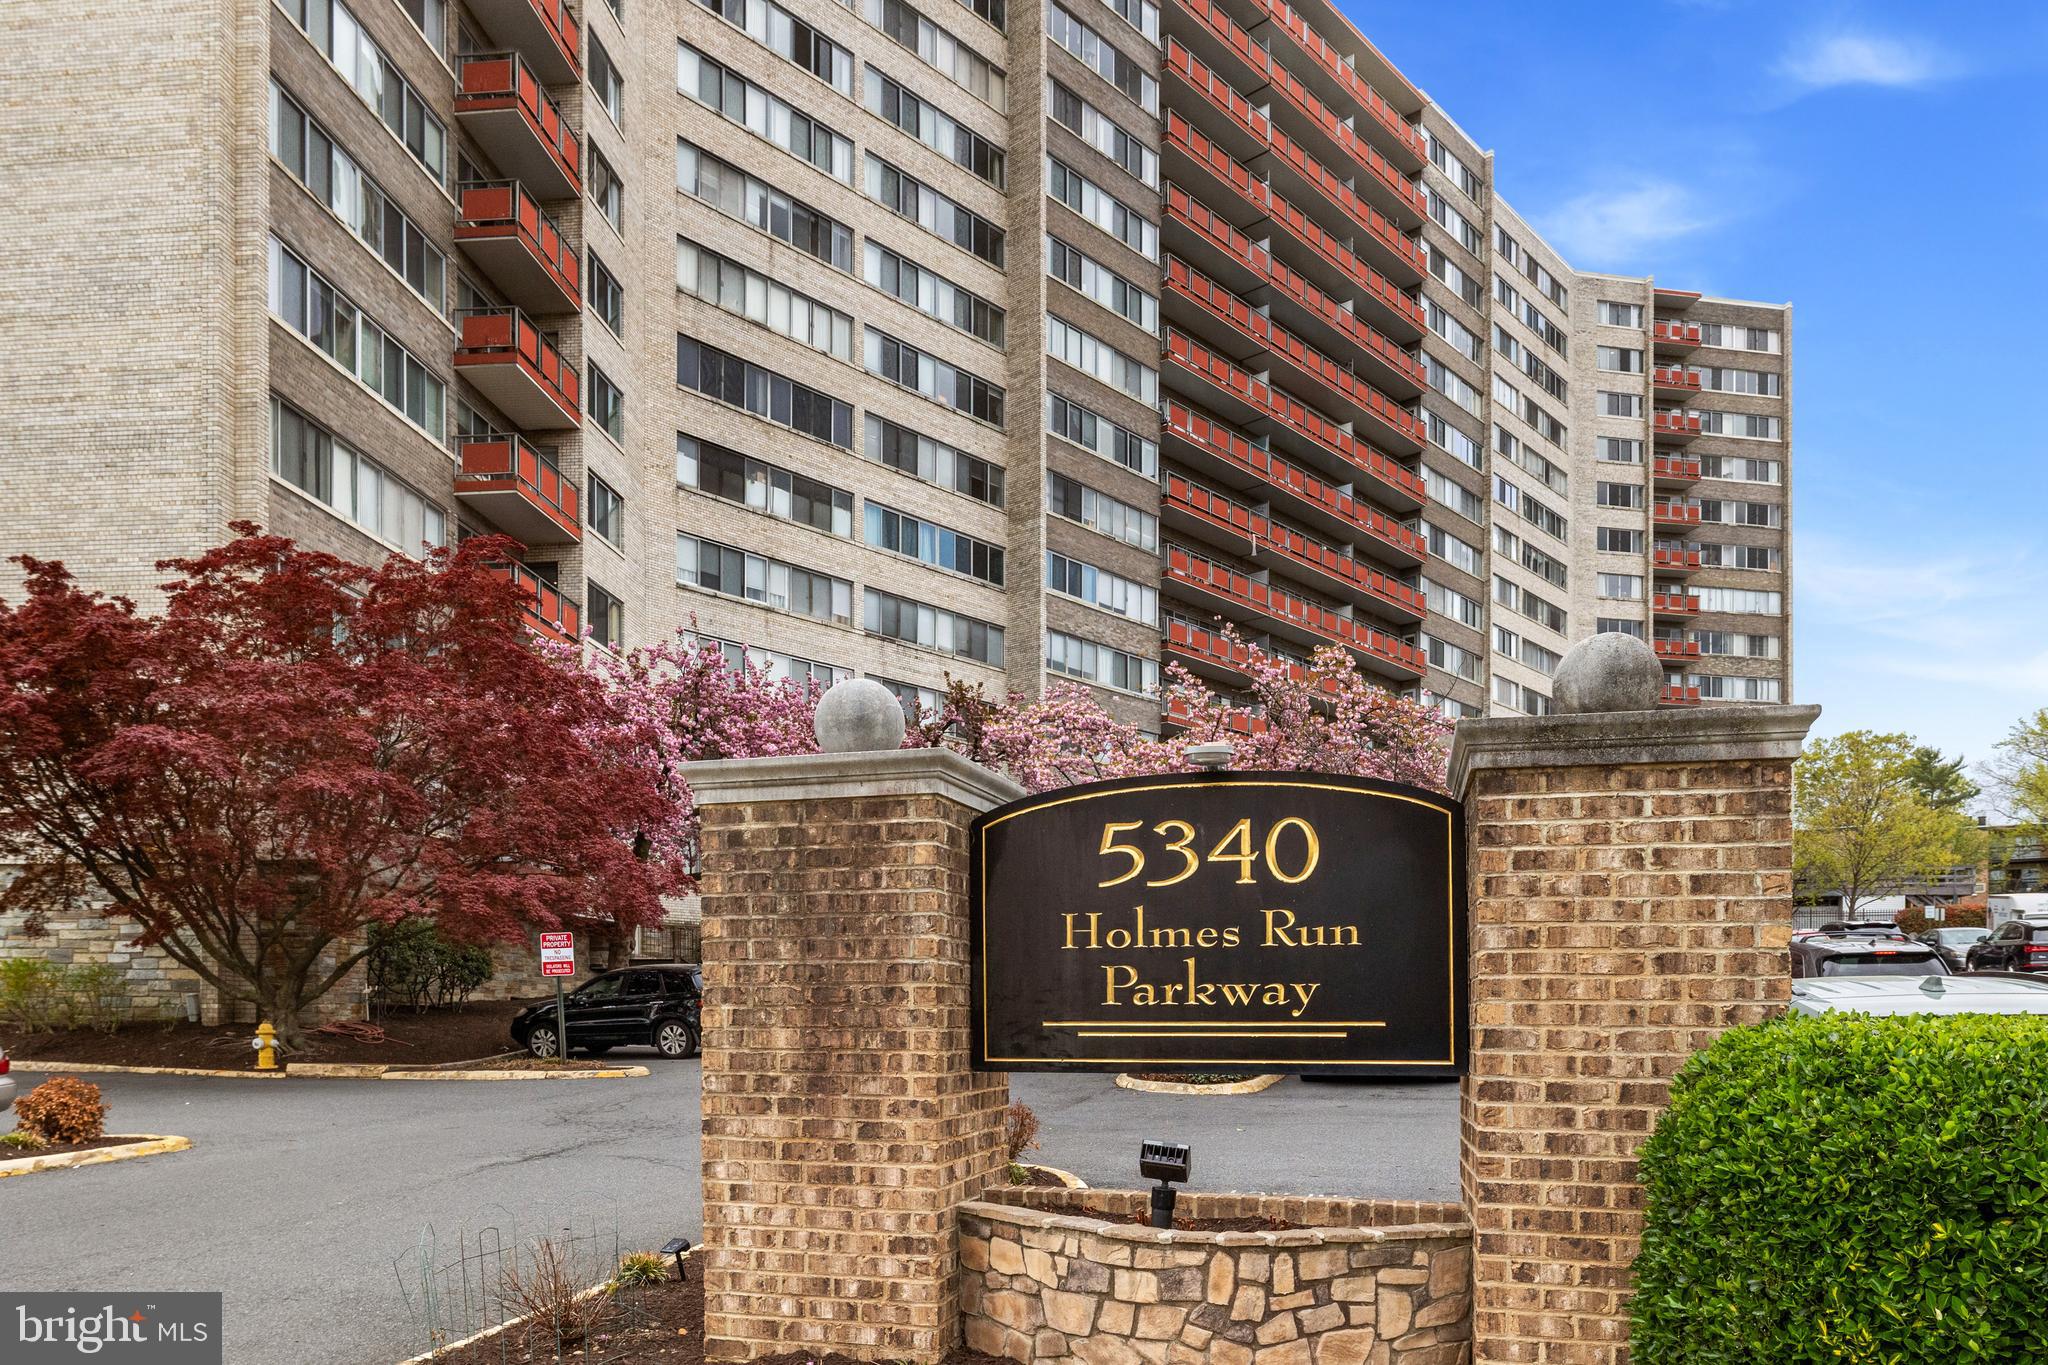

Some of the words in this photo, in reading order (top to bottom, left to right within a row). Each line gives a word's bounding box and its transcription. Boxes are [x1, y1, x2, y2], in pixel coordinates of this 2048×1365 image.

[1098, 816, 1320, 888] 5340
[1061, 905, 1240, 950] Holmes
[1260, 908, 1363, 948] Run
[1100, 957, 1321, 1017] Parkway
